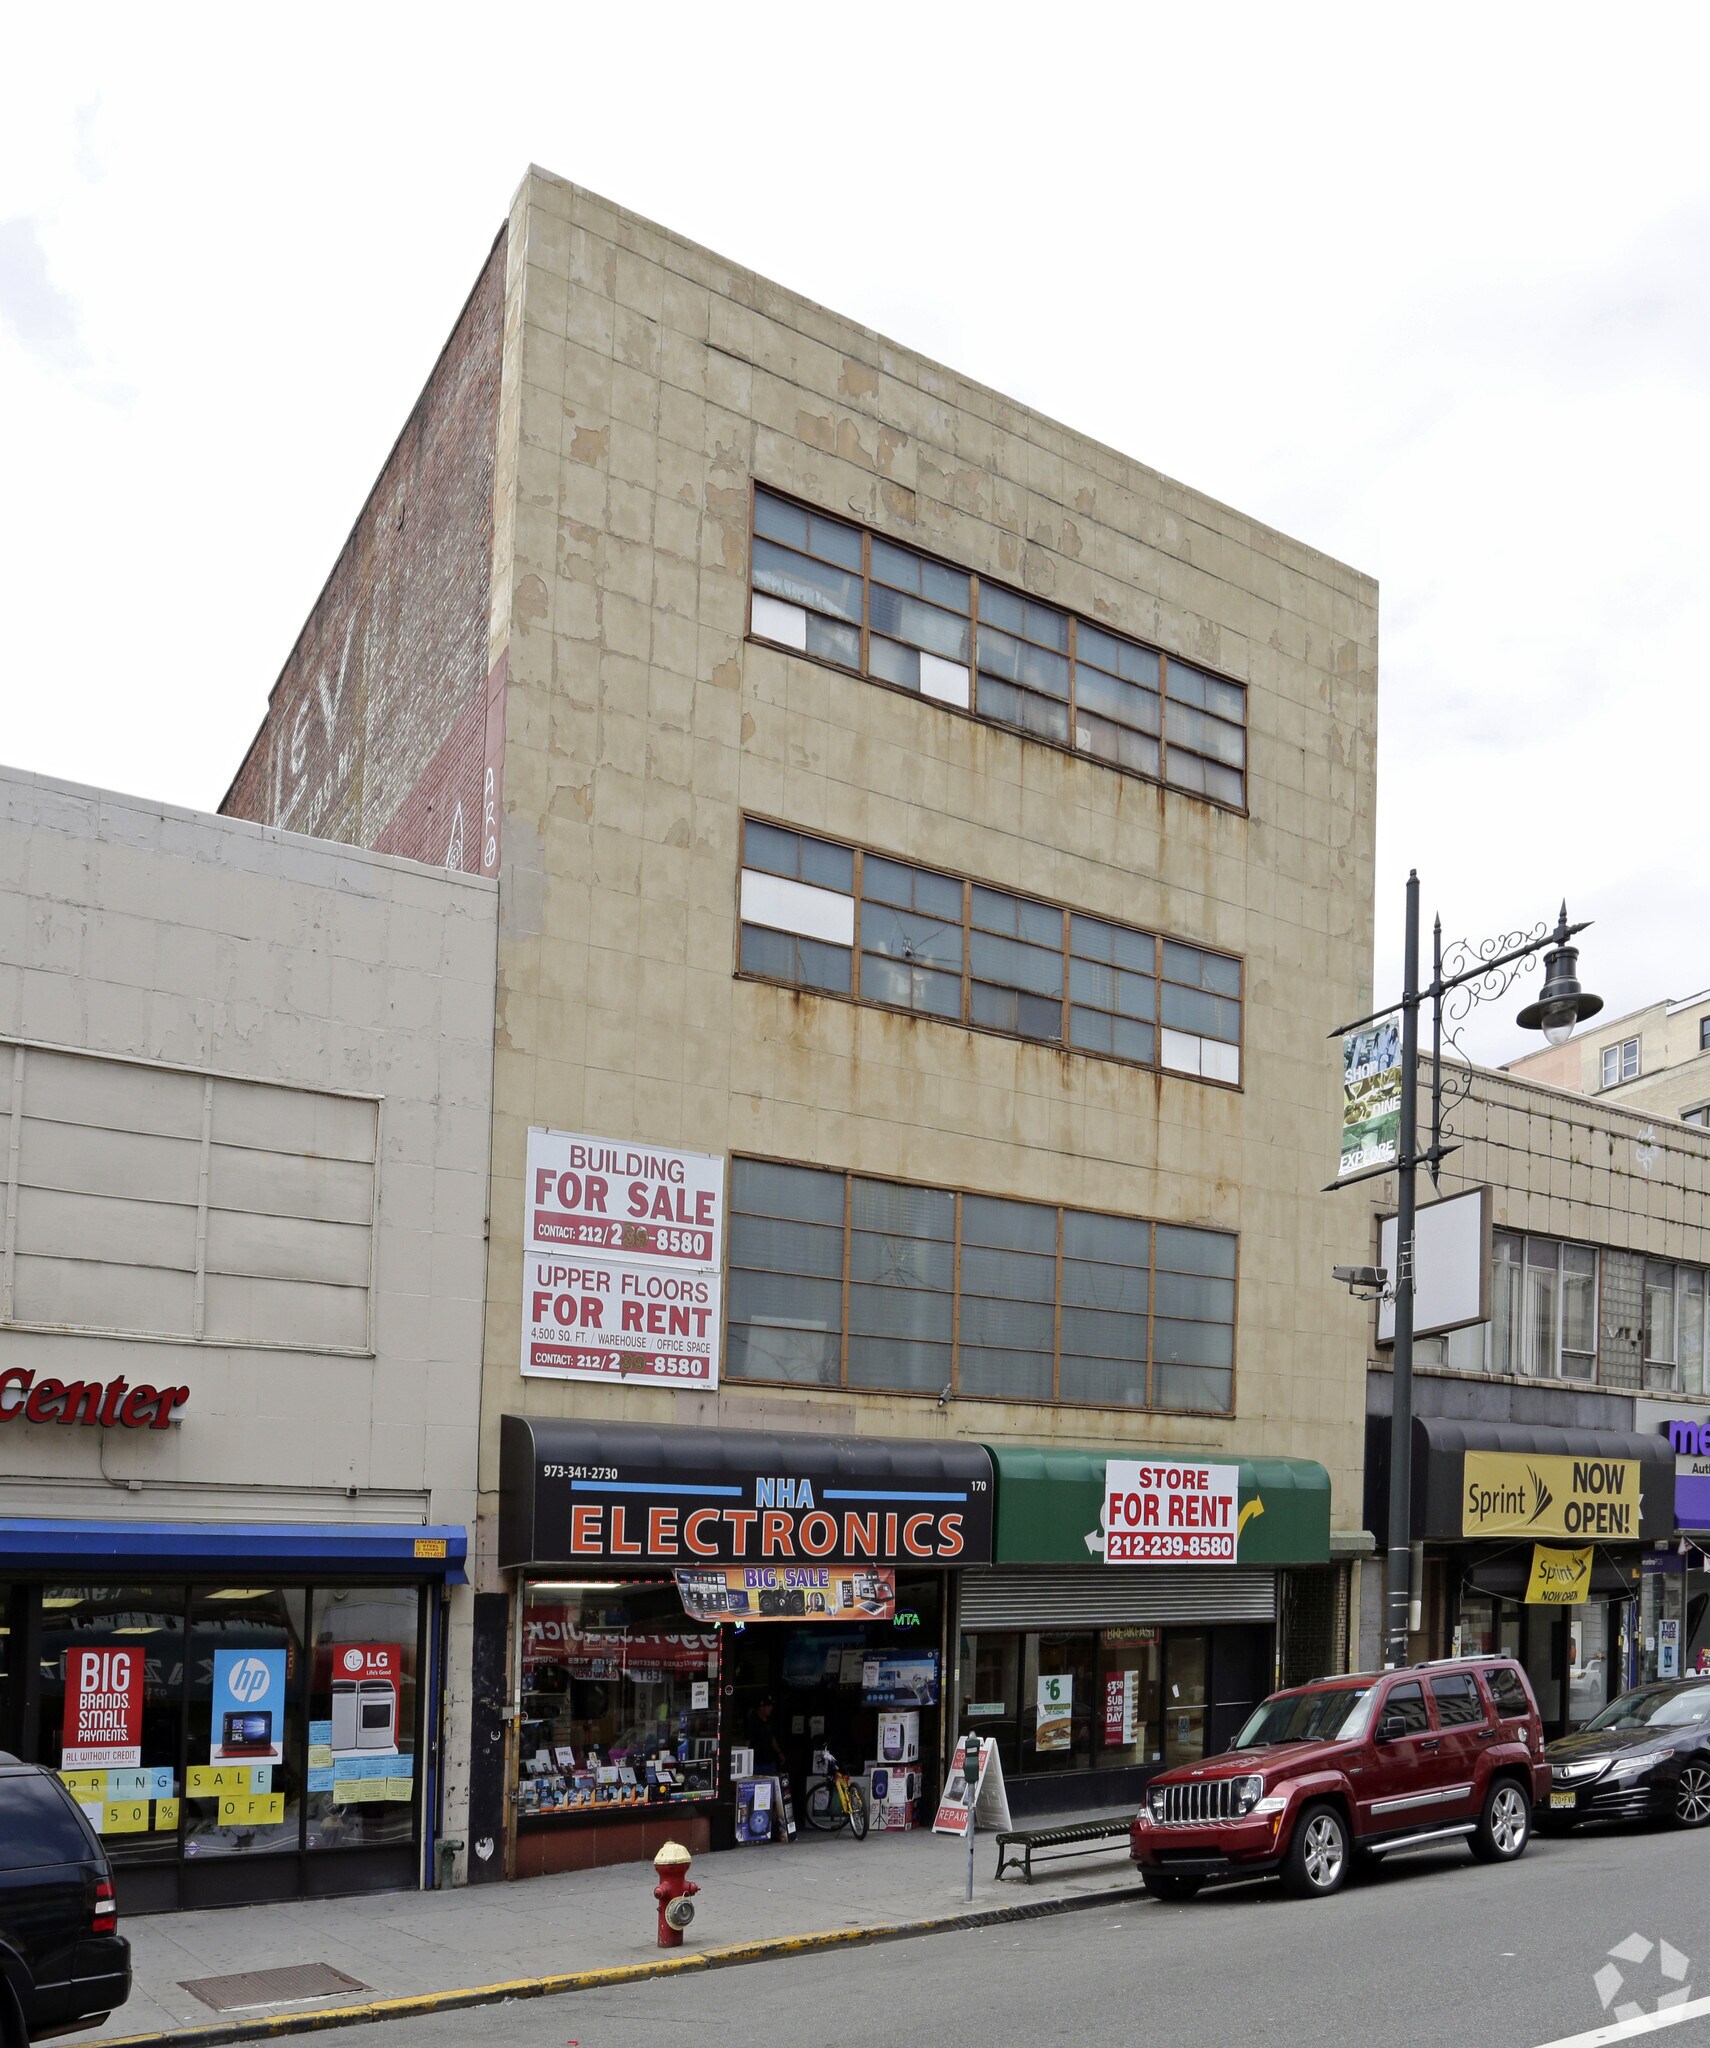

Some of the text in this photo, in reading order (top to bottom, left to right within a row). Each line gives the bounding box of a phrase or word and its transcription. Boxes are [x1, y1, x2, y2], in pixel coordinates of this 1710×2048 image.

[1345, 1061, 1378, 1083] SHOP
[570, 1144, 685, 1184] BUILDING
[535, 1167, 716, 1227] FOR SALE
[538, 1223, 576, 1240] CONTACT:
[537, 1264, 709, 1303] UPPER FLOORS
[532, 1291, 713, 1338] FOR RENT
[531, 1327, 555, 1341] 4,500
[558, 1330, 573, 1342] SQ.
[575, 1331, 588, 1343] FT.
[598, 1333, 647, 1348] WAREHOUSE
[657, 1338, 684, 1352] OFFICE
[686, 1340, 711, 1354] SPACE
[535, 1352, 574, 1366] CONTACT:
[0, 1367, 190, 1429] Center
[543, 1464, 618, 1481] 973-341-2730
[1139, 1467, 1209, 1490] STORE
[1572, 1461, 1625, 1494] NOW
[755, 1477, 815, 1509] NHA
[971, 1480, 987, 1493] 170
[1109, 1492, 1233, 1528] FOR RENT
[1468, 1482, 1526, 1522] Sprint
[1564, 1501, 1631, 1534] OPEN!
[570, 1504, 965, 1558] ELECTRONICS
[1110, 1535, 1232, 1557] 212-239-8580
[743, 1566, 831, 1589] BIG SALE
[1538, 1559, 1575, 1584] Sprint
[1541, 1590, 1578, 1602] NOW OPEN
[1662, 1621, 1676, 1630] TWO
[1662, 1630, 1676, 1639] FREE
[366, 1652, 388, 1668] LG
[80, 1653, 131, 1692] BIG
[234, 1659, 266, 1702] hp
[79, 1693, 130, 1709] BRANDS.
[1045, 1678, 1060, 1701] $6
[1107, 1695, 1124, 1705] SUB
[79, 1710, 128, 1728] SMALL
[1106, 1712, 1123, 1723] DAY
[78, 1729, 129, 1742] PAYMENTS.
[66, 1750, 136, 1761] ALL WITHOUT CREDIT.
[65, 1770, 266, 1793] PRING SALE
[224, 1800, 278, 1815] OFF
[939, 1809, 968, 1822] REPAIR
